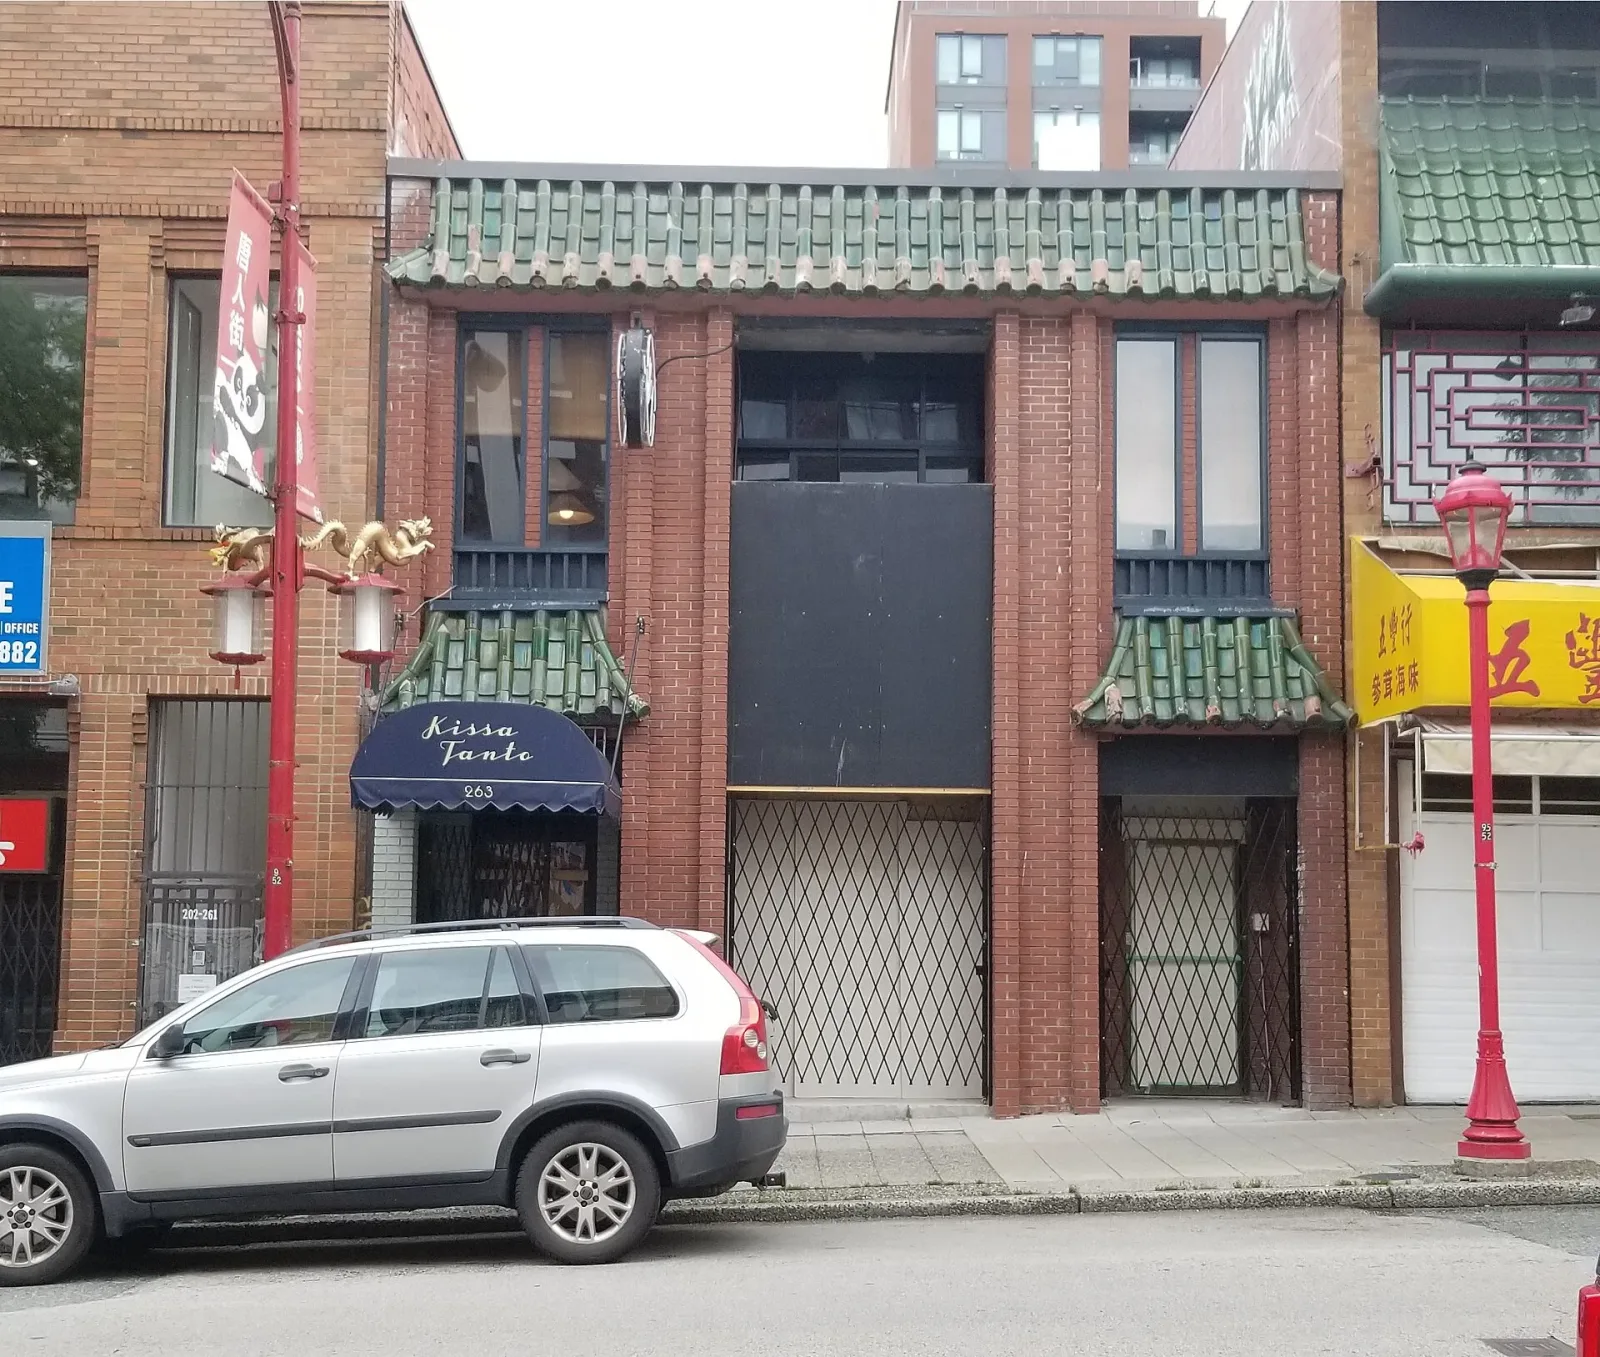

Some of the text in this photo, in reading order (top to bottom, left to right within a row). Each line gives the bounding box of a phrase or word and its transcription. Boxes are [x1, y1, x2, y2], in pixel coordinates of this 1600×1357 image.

[4, 622, 39, 635] OFFICE
[422, 715, 519, 739] Kissa
[440, 739, 534, 766] Tanto
[464, 785, 494, 798] 263
[1481, 832, 1492, 841] 52
[273, 868, 280, 877] 9
[272, 876, 282, 885] 52
[182, 908, 218, 920] 202-261
